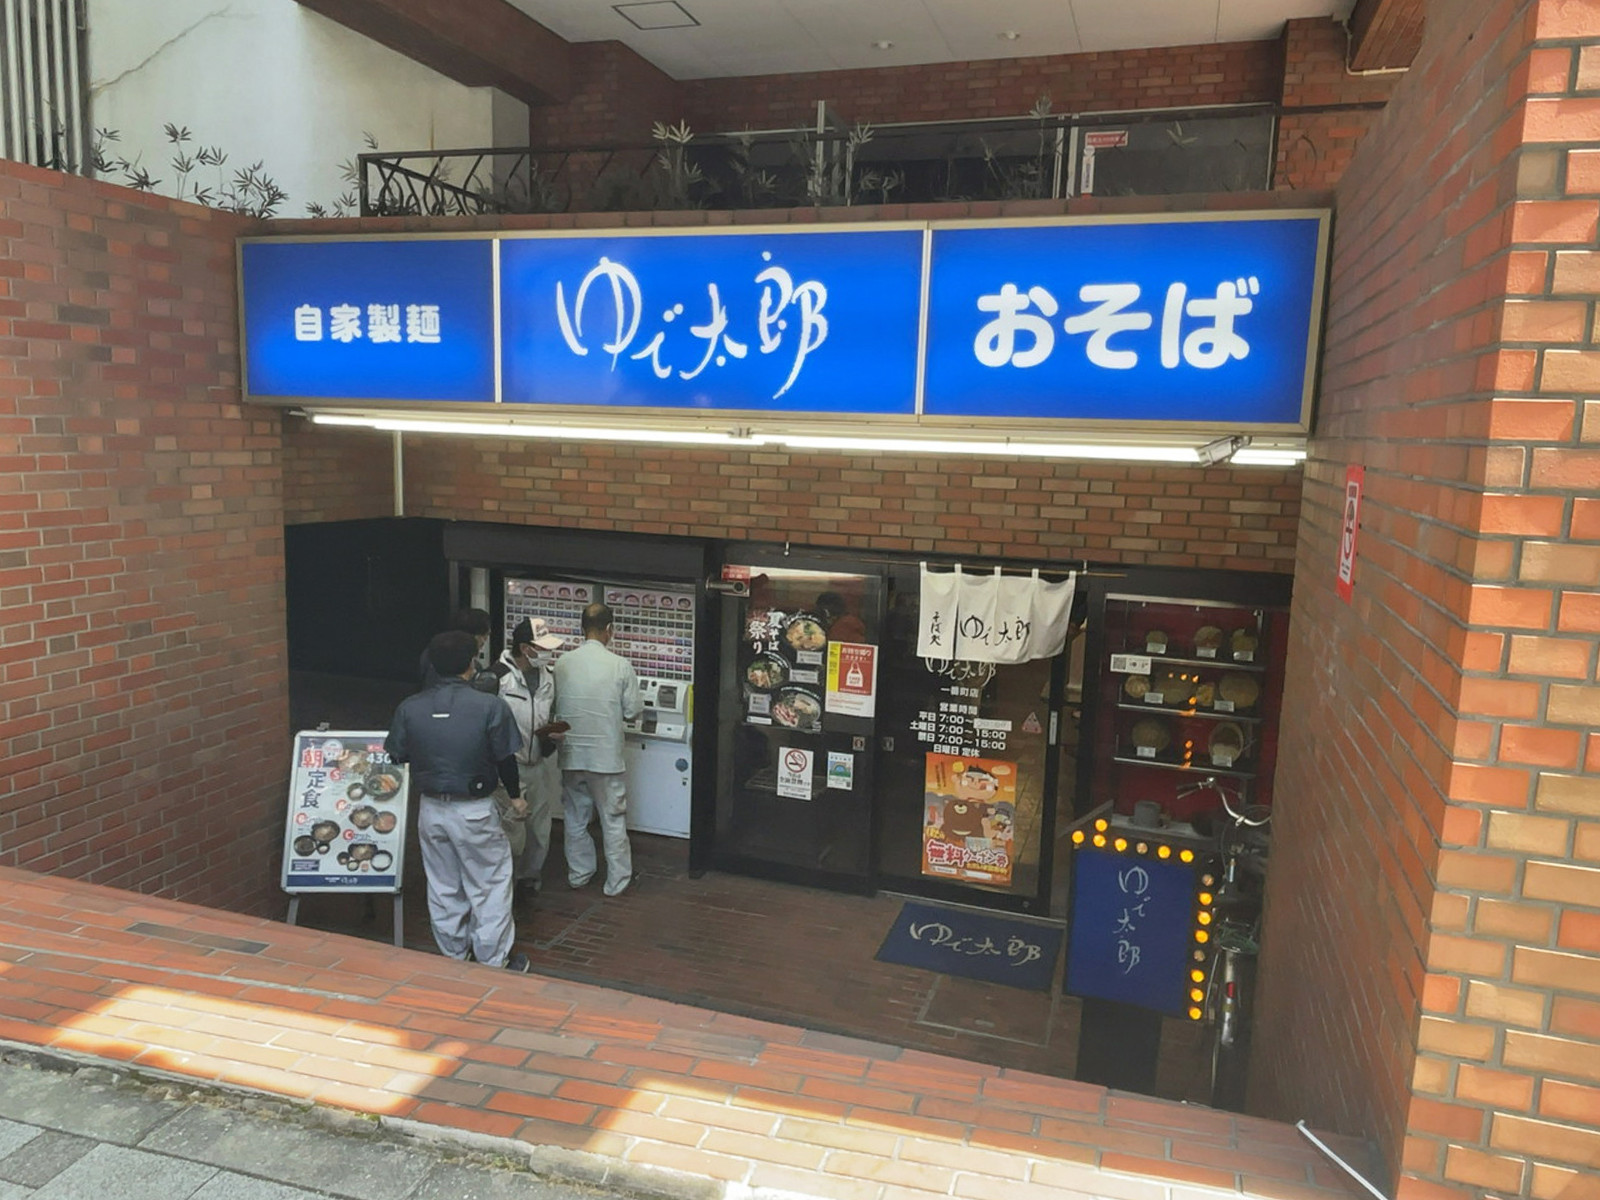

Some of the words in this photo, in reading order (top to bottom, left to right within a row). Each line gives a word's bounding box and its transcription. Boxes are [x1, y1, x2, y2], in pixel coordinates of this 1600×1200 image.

[294, 304, 441, 343] 自家製麺
[556, 252, 828, 399] ゆで太郎
[974, 276, 1260, 369] おそば
[749, 620, 767, 655] 祭り
[960, 615, 1031, 652] ゆで太郎
[940, 702, 978, 715] 営業時間
[941, 685, 979, 698] 一番町店
[909, 720, 936, 732] 土曜日
[919, 711, 936, 722] 平日
[933, 743, 959, 755] 日曜日
[961, 747, 980, 757] 定休
[1113, 865, 1151, 974] ゆで太郎
[910, 922, 1041, 966] ゆで太郎
